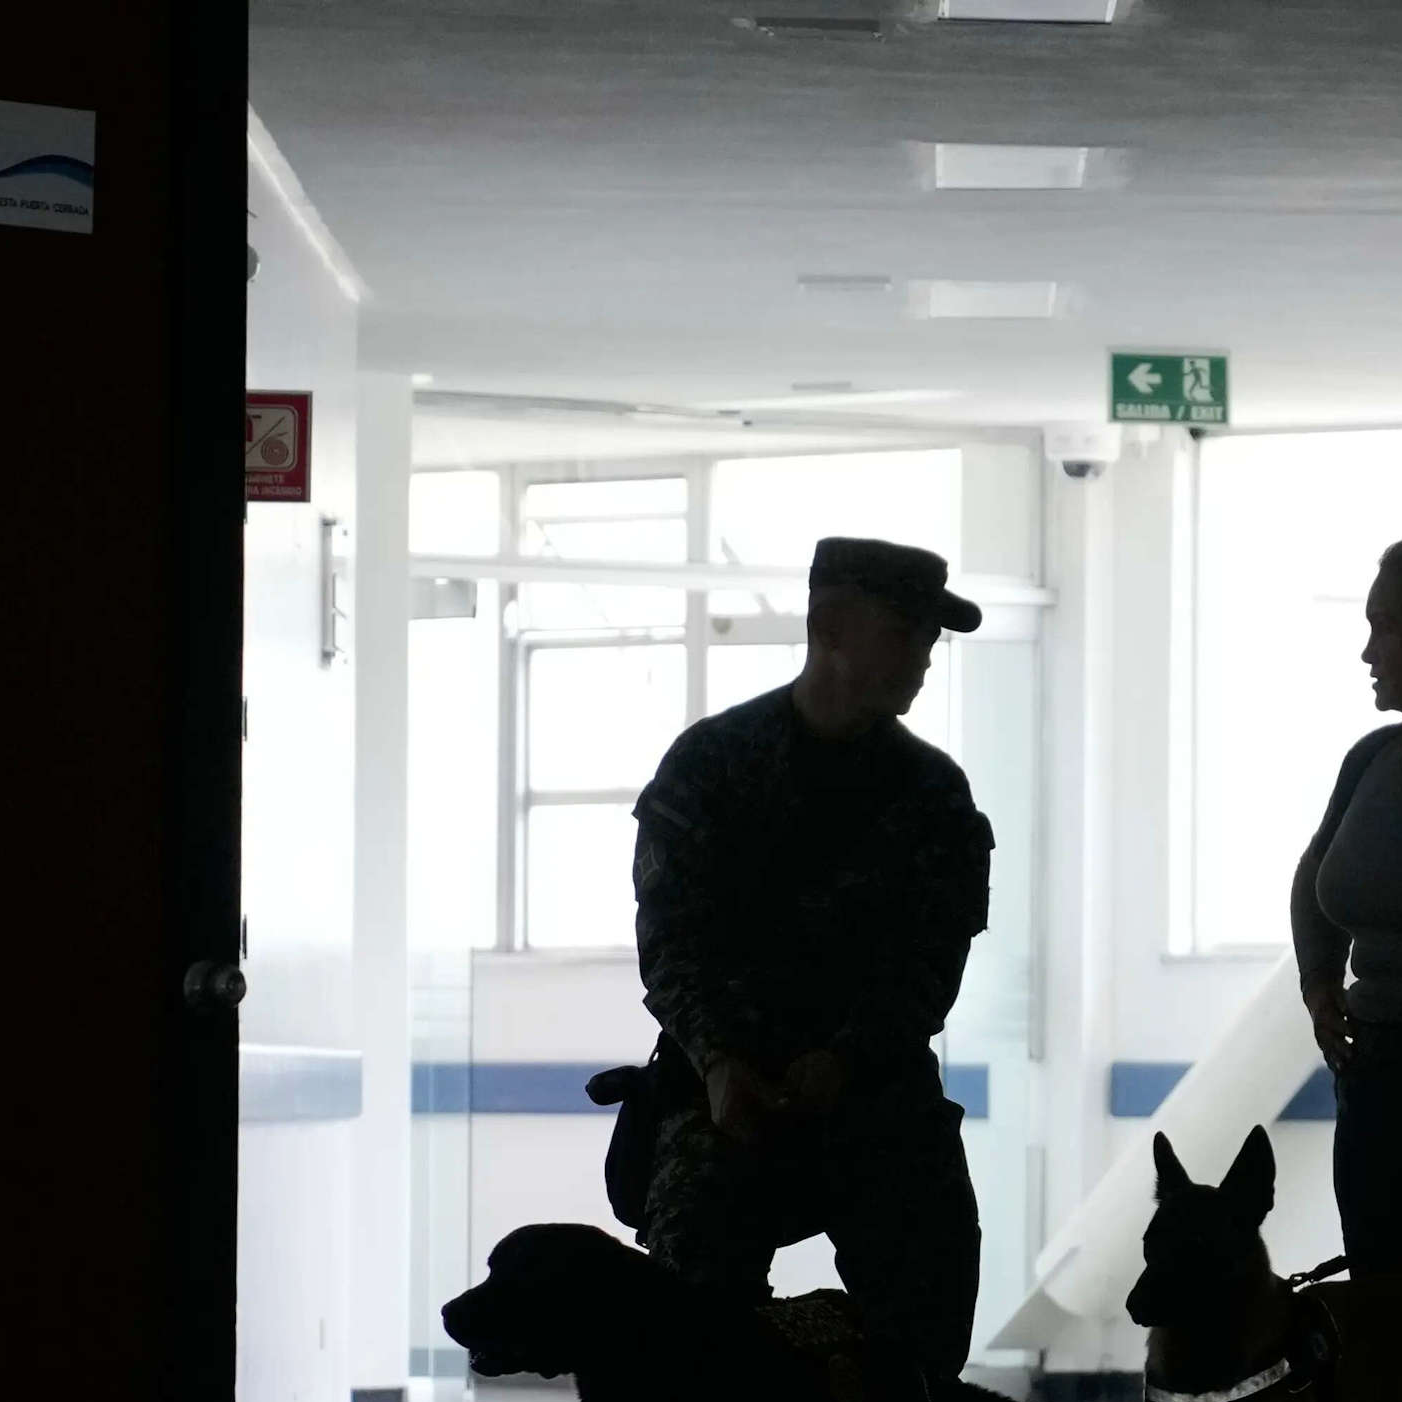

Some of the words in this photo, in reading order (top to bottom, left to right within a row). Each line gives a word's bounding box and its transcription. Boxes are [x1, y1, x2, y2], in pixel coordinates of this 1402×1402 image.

[20, 199, 50, 211] PUERTA
[53, 203, 89, 215] CERRADA
[1116, 403, 1170, 419] SALIDA
[1190, 406, 1223, 421] EXIT
